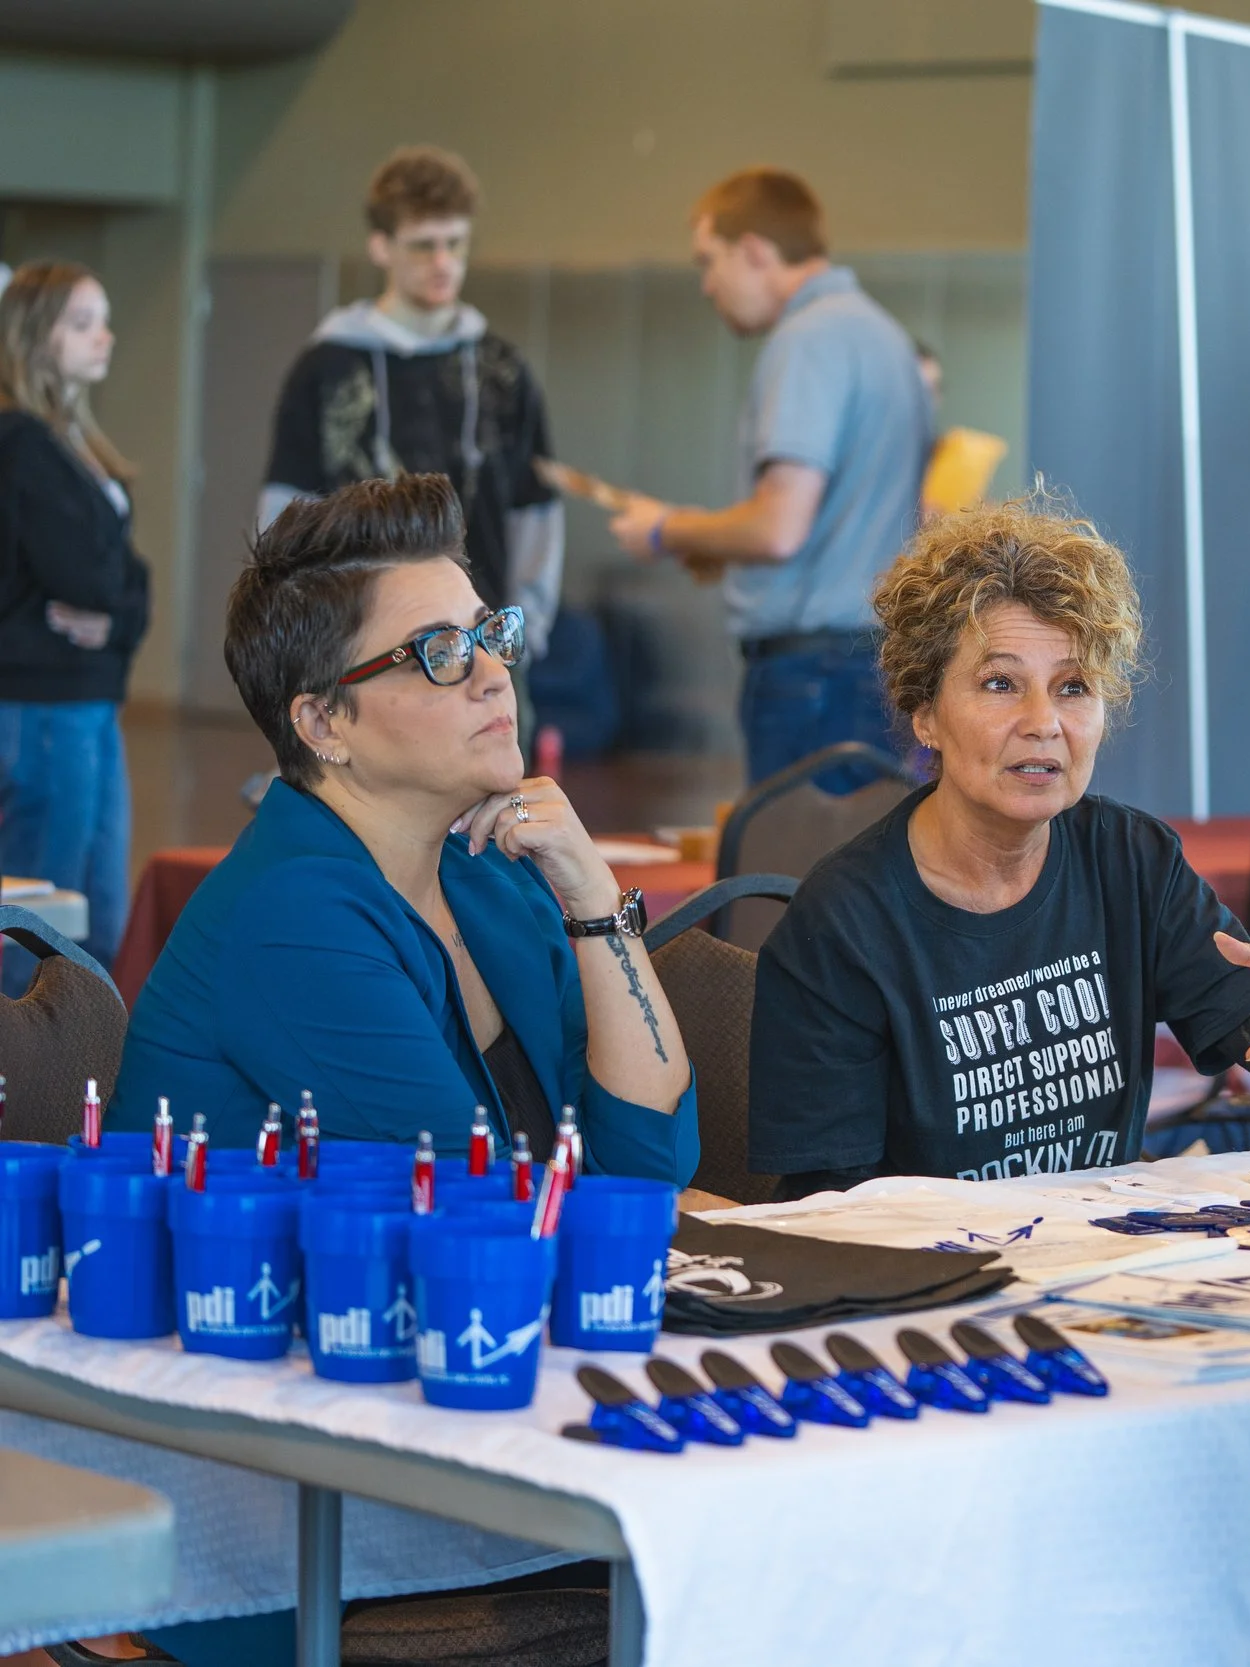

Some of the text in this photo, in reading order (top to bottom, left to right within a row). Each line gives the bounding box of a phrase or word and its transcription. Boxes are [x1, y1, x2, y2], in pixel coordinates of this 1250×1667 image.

[939, 991, 973, 1012] never
[974, 971, 1031, 1004] dreamed
[1034, 957, 1072, 984] would
[1073, 954, 1090, 970] be
[1091, 950, 1101, 965] a
[939, 998, 1032, 1065] SUPER
[953, 1027, 1116, 1102] DIRECT SUPPORT
[956, 1061, 1126, 1134] PROFESSIONAL
[1004, 1114, 1085, 1149] But here I am
[956, 1136, 1082, 1182] OCKIN'
[186, 1285, 236, 1333] pdi
[319, 1307, 371, 1354] pdi
[580, 1285, 635, 1331] pdi
